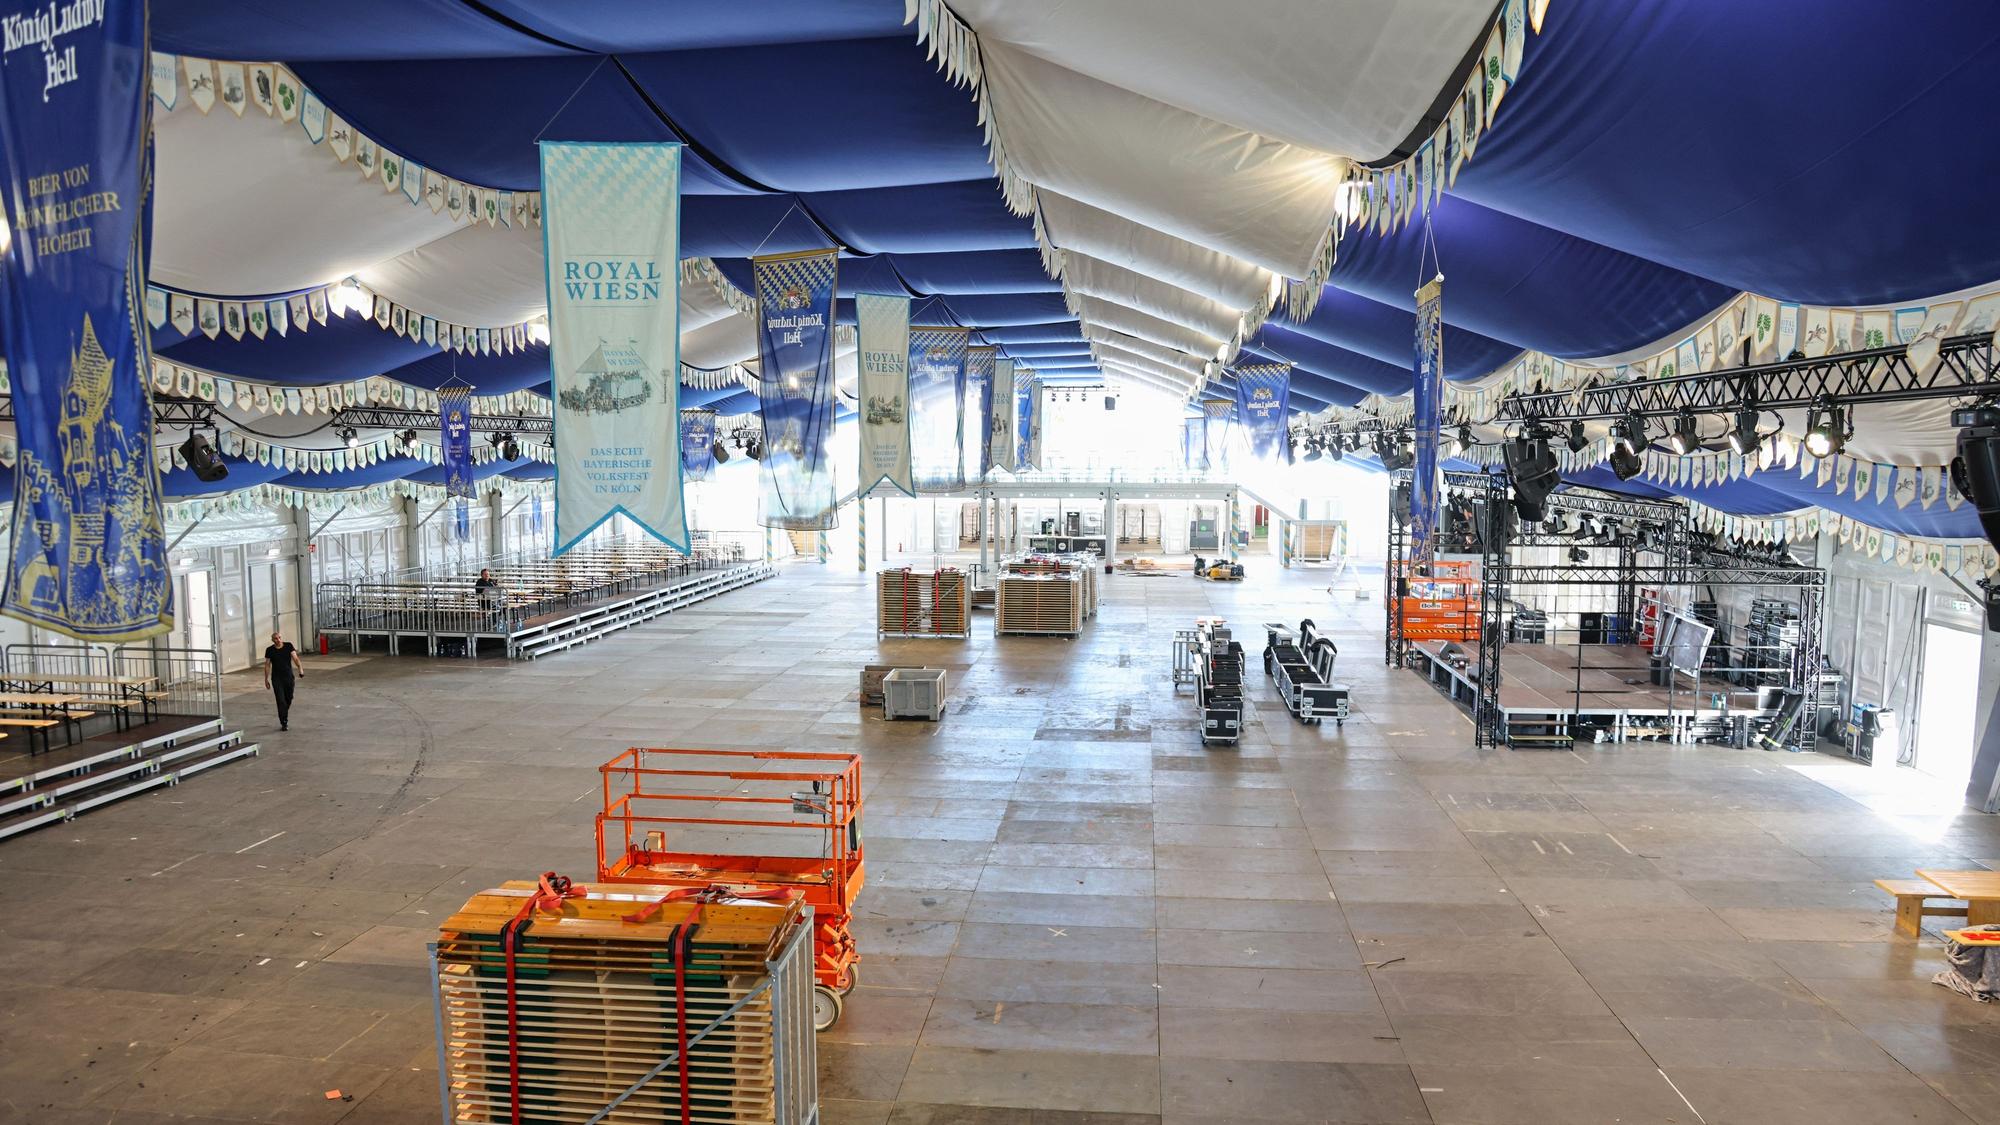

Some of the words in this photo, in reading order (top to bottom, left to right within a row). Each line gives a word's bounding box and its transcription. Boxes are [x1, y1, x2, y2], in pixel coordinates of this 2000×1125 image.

[1, 8, 50, 65] König
[43, 45, 78, 103] Hell
[28, 172, 61, 198] BIER
[63, 163, 89, 188] VON
[38, 227, 92, 256] HOHEIT
[564, 261, 661, 280] ROYAL
[564, 281, 661, 301] WIESN
[864, 351, 904, 363] ROYAL
[866, 363, 904, 373] WIESN
[590, 447, 612, 456] DAS
[614, 447, 644, 456] ECHT
[583, 459, 652, 469] BAYERISCHE
[587, 472, 649, 481] VOLKSFEST
[594, 484, 608, 493] IN
[611, 483, 641, 494] KÖLN
